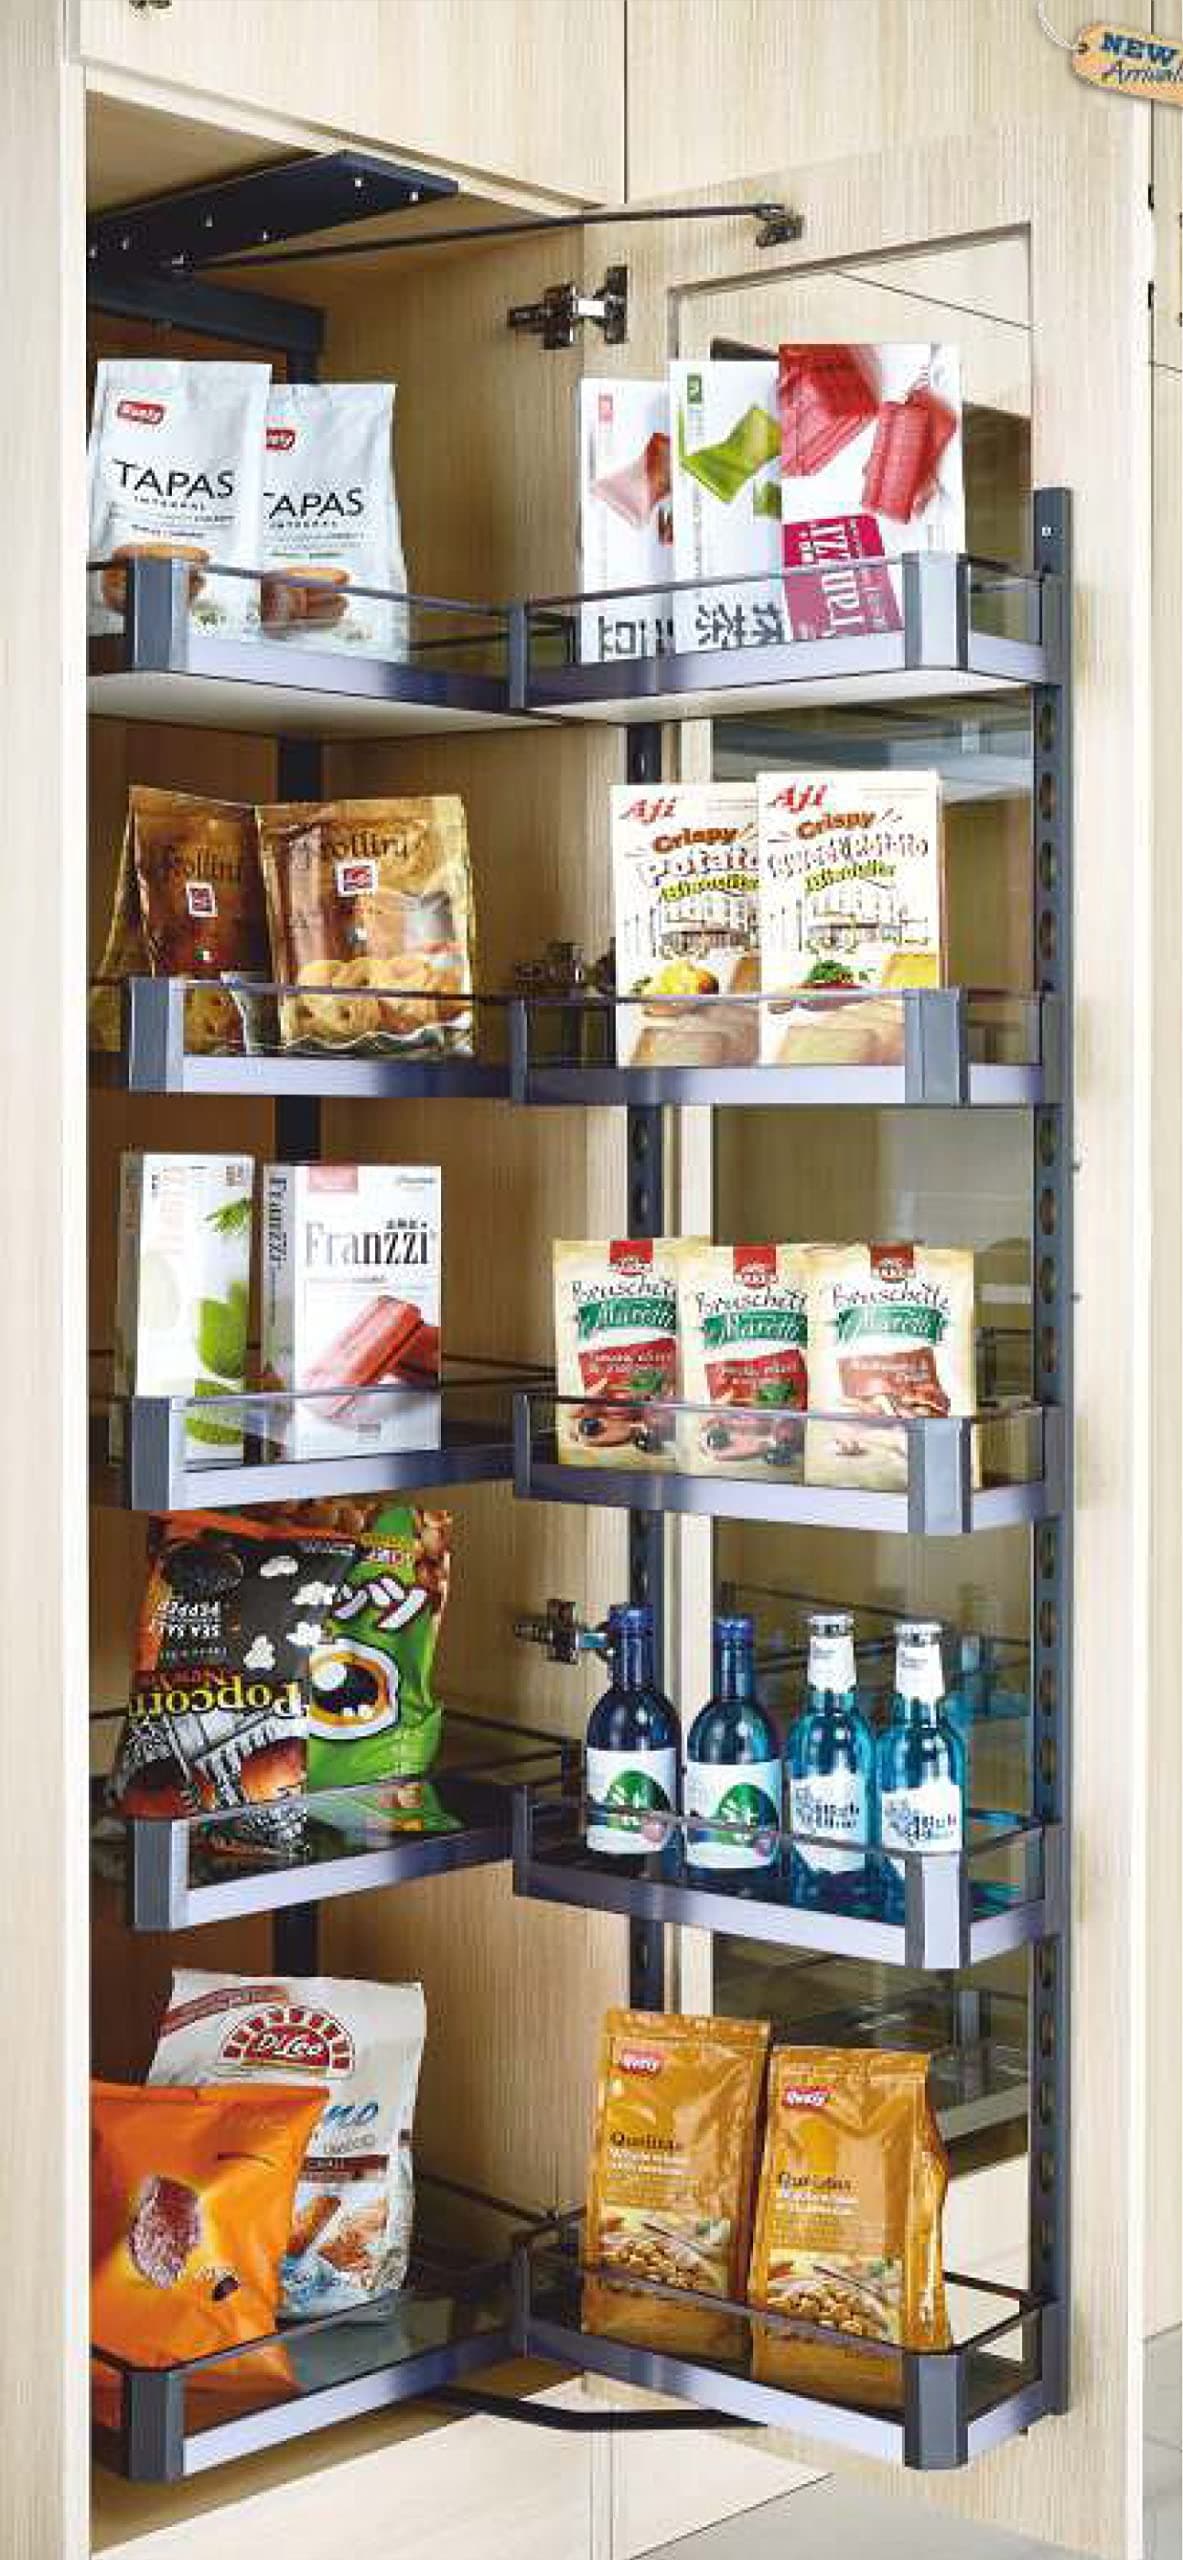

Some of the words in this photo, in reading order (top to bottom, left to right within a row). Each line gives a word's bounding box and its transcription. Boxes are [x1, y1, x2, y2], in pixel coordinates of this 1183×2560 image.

[112, 458, 235, 500] TAPAS
[653, 824, 739, 852] Crispy
[797, 810, 877, 841] Crispy
[268, 1177, 288, 1262] Franzzi
[306, 1220, 430, 1266] Franzzi
